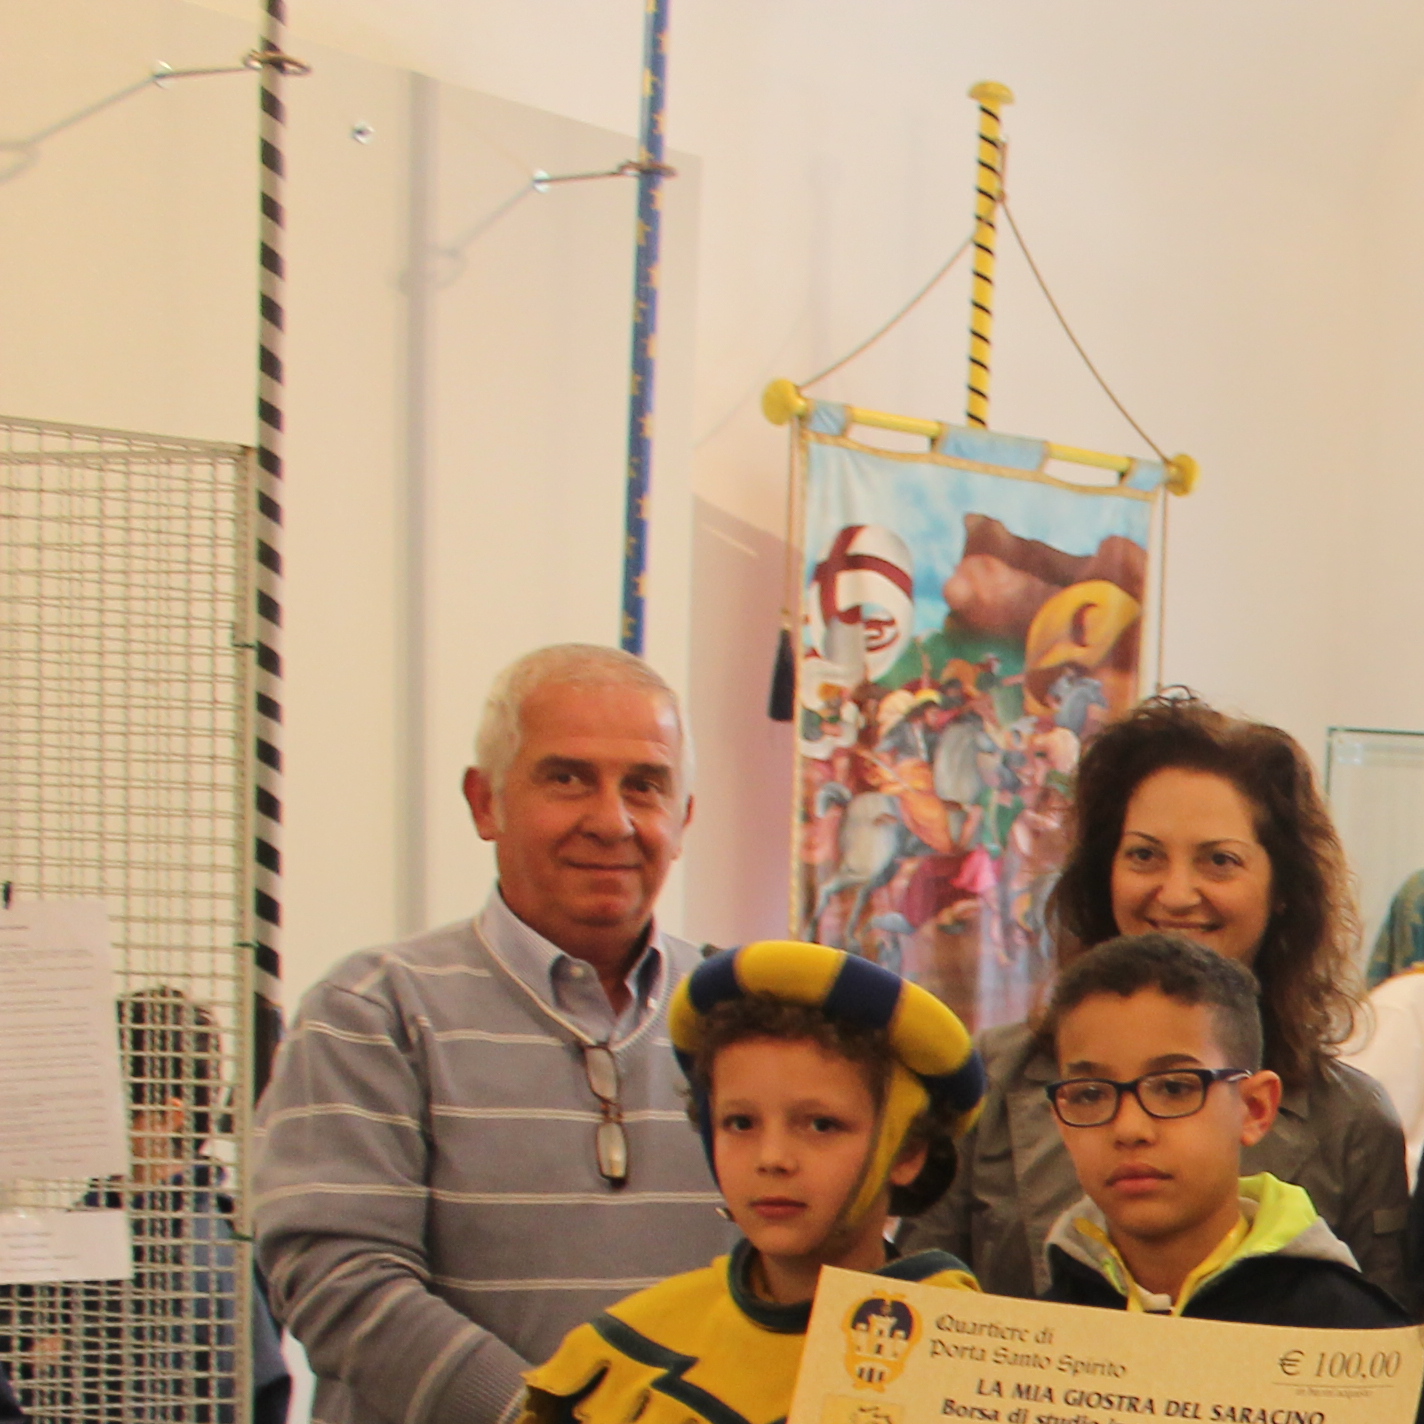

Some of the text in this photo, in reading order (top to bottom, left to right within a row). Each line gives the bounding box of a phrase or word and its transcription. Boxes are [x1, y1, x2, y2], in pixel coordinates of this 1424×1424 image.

[935, 1314, 1054, 1345] Quartiere di
[930, 1339, 1127, 1379] Porta Santo Spirito
[1279, 1350, 1305, 1376] €
[941, 1398, 998, 1422] Borsa
[1007, 1408, 1028, 1424] di
[976, 1379, 1002, 1397] LA
[1012, 1383, 1055, 1404] MIA
[1063, 1389, 1155, 1415] GIOSTRA
[1164, 1400, 1202, 1420] DEL
